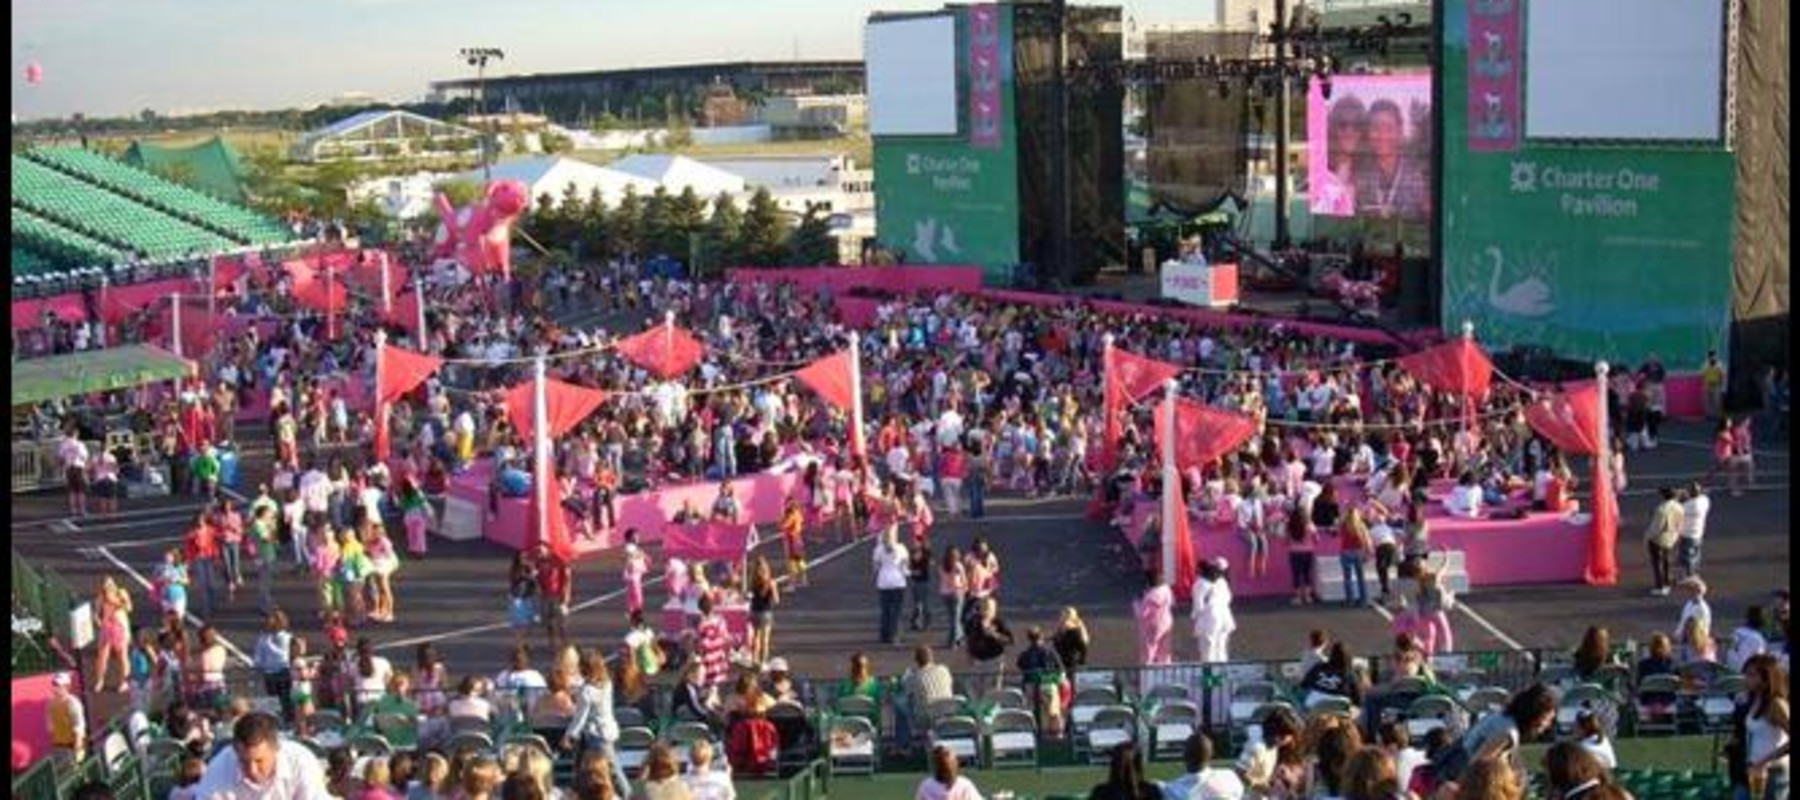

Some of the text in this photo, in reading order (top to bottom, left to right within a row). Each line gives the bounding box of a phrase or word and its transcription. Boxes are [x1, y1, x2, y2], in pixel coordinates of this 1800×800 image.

[1541, 167, 1660, 190] Charter One
[1560, 193, 1638, 217] Pavilion
